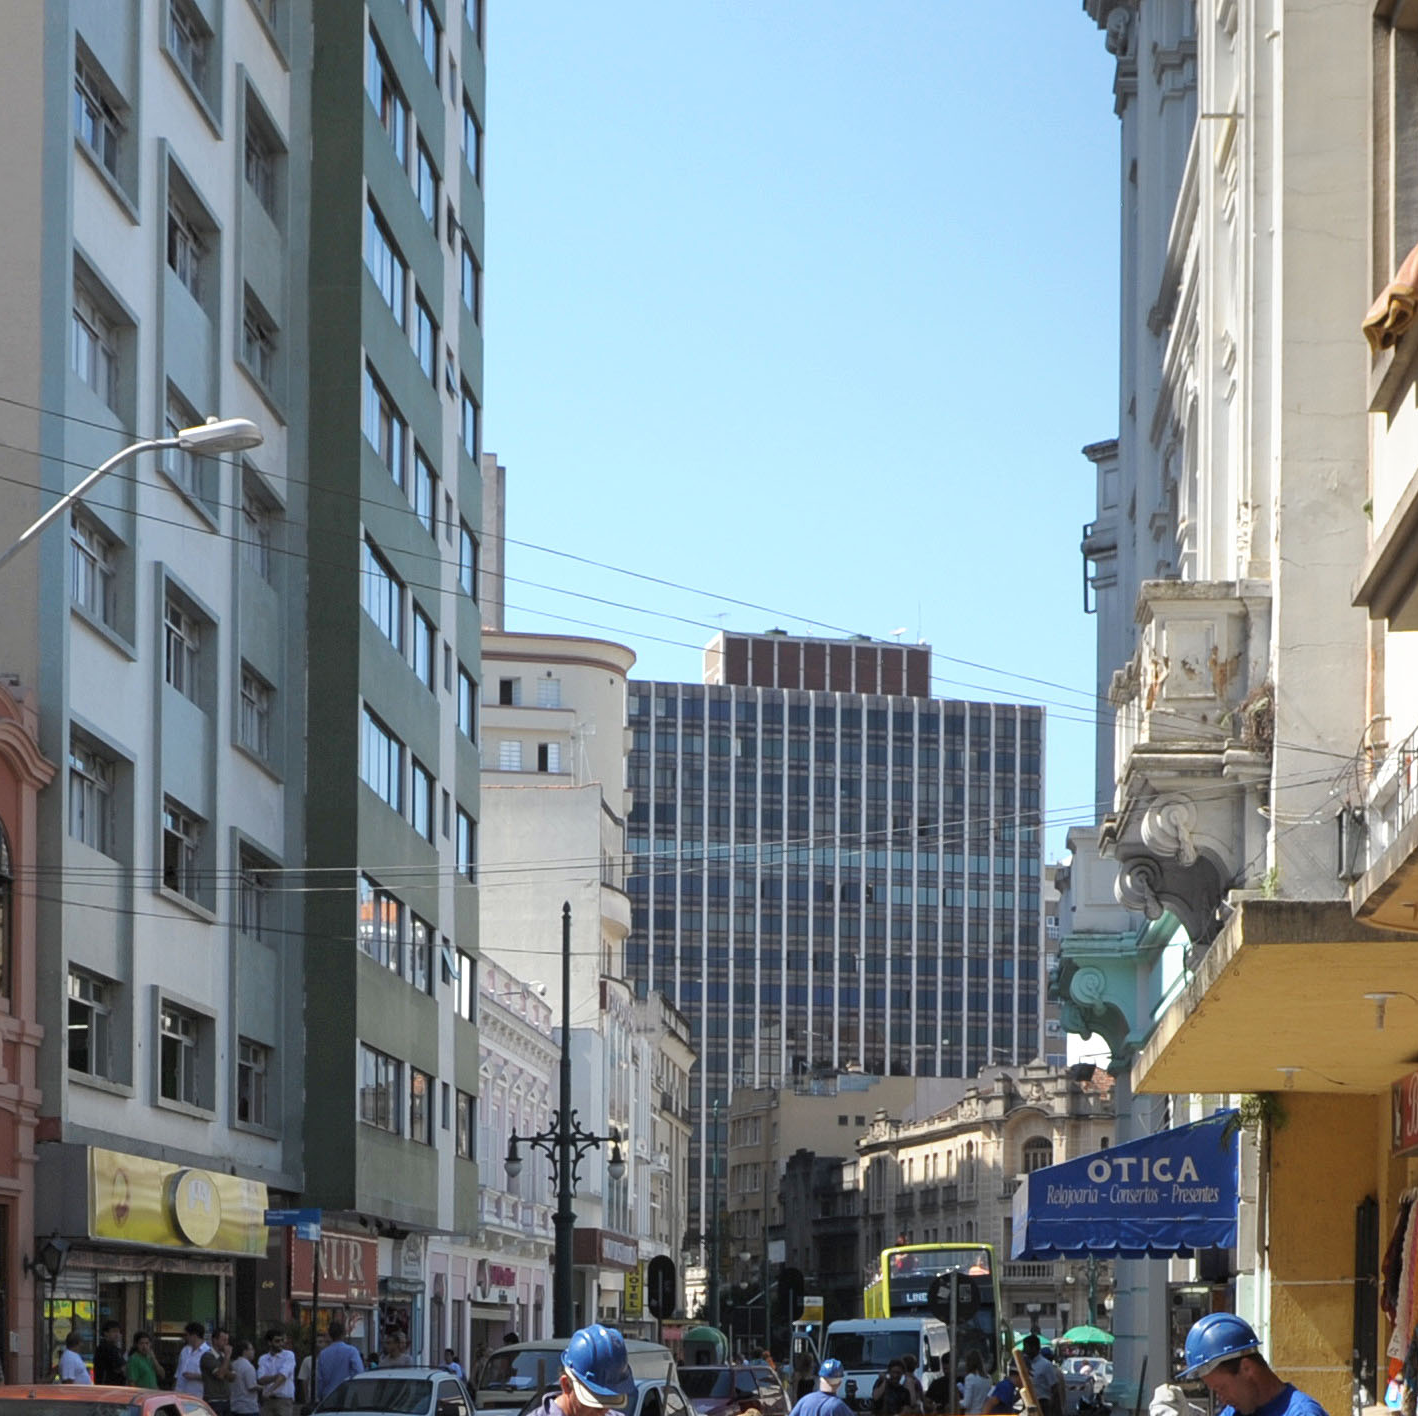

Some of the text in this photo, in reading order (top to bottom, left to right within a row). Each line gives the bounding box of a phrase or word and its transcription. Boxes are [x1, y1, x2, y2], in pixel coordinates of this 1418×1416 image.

[1087, 1155, 1200, 1184] ÓTICA
[1109, 1184, 1159, 1205] Consertos
[1171, 1184, 1220, 1205] Presentes
[628, 1271, 639, 1308] OTEL
